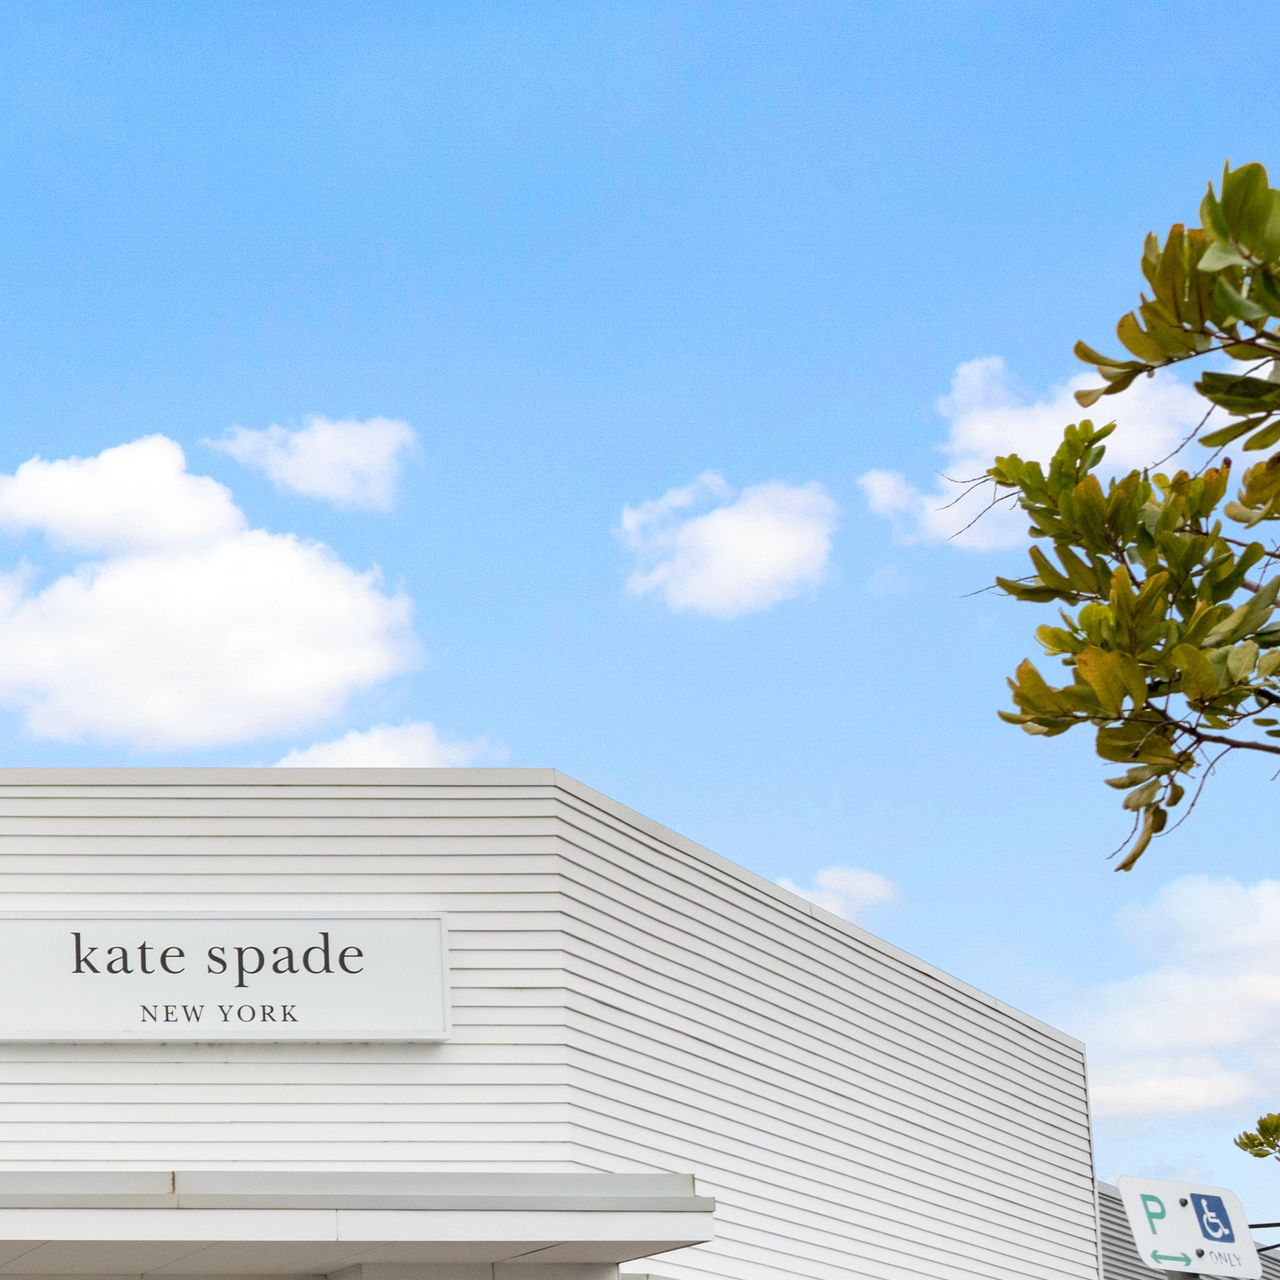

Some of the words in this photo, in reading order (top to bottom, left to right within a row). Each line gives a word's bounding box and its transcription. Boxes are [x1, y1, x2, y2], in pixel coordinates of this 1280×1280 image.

[70, 932, 186, 975] kate
[207, 931, 365, 988] spade
[140, 1004, 205, 1023] NEW
[217, 1004, 299, 1023] YORK
[1140, 1193, 1166, 1235] P
[1209, 1250, 1242, 1267] ONLY
